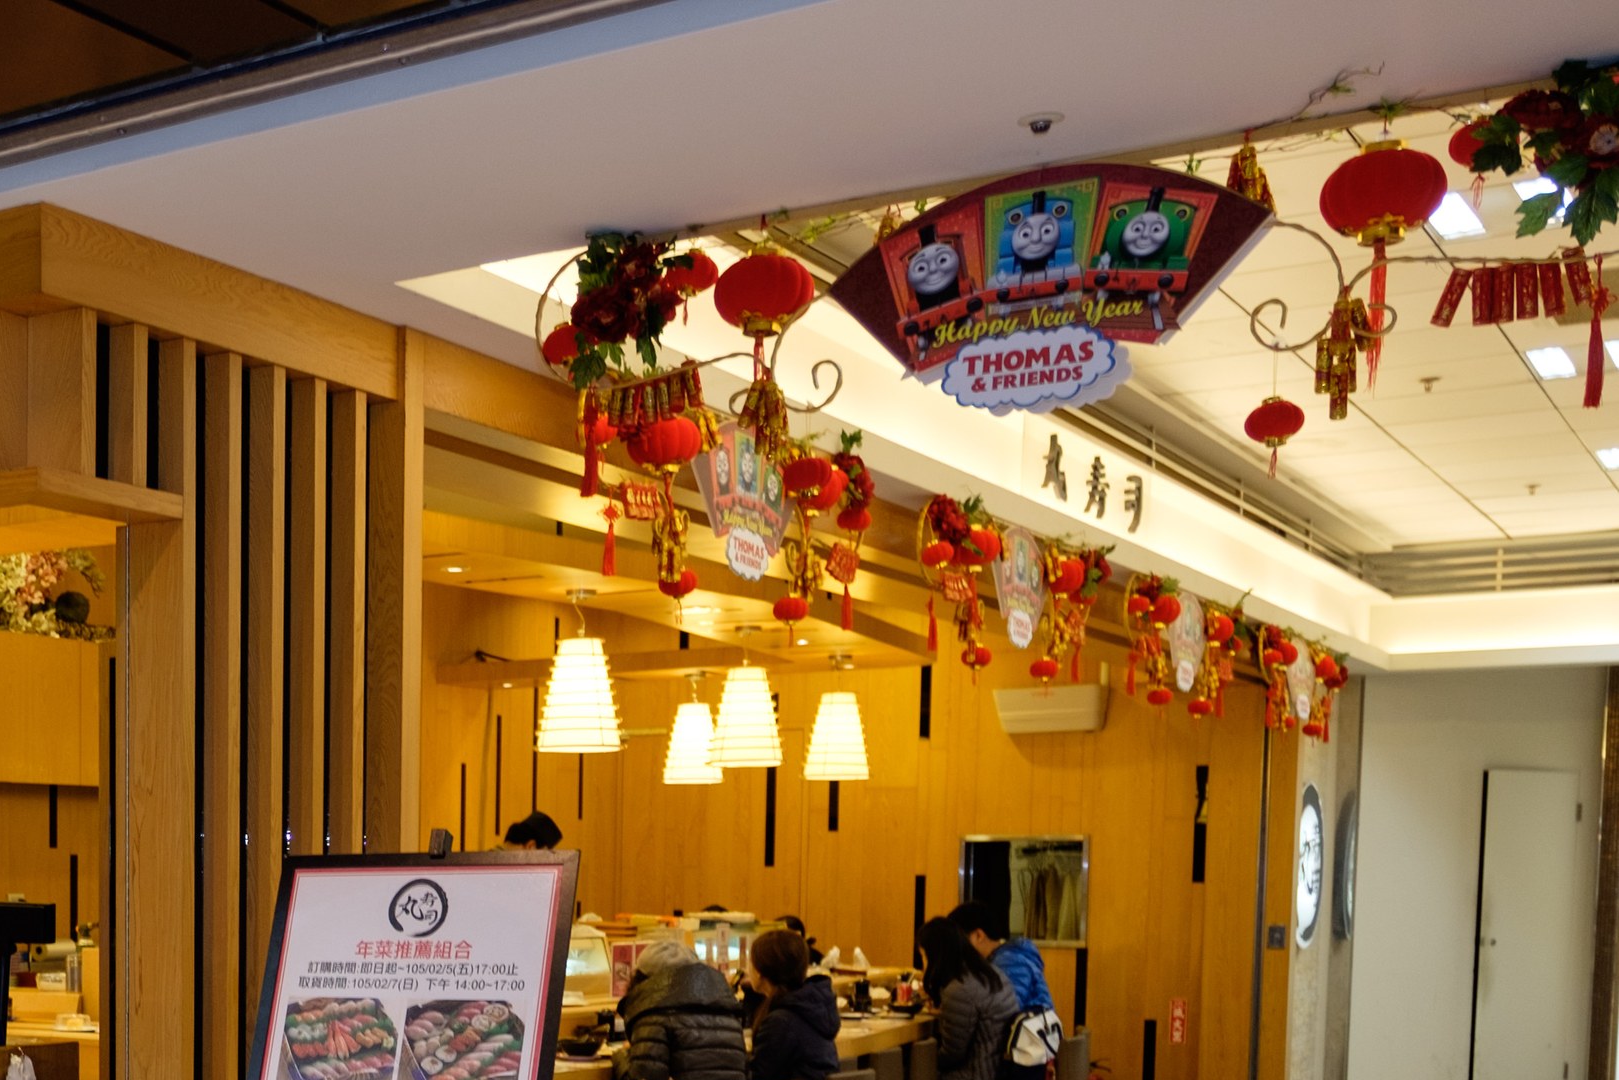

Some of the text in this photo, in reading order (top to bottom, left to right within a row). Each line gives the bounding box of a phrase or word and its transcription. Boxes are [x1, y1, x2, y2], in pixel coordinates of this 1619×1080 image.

[932, 297, 1144, 348] Happy New Year
[963, 340, 1095, 377] THOMAS
[971, 365, 1083, 394] & FRIENDS
[733, 536, 764, 560] THOMAS
[355, 940, 473, 960] 年菜推薦組合
[426, 978, 450, 992] 下午
[455, 979, 525, 992] 14:00~17:00
